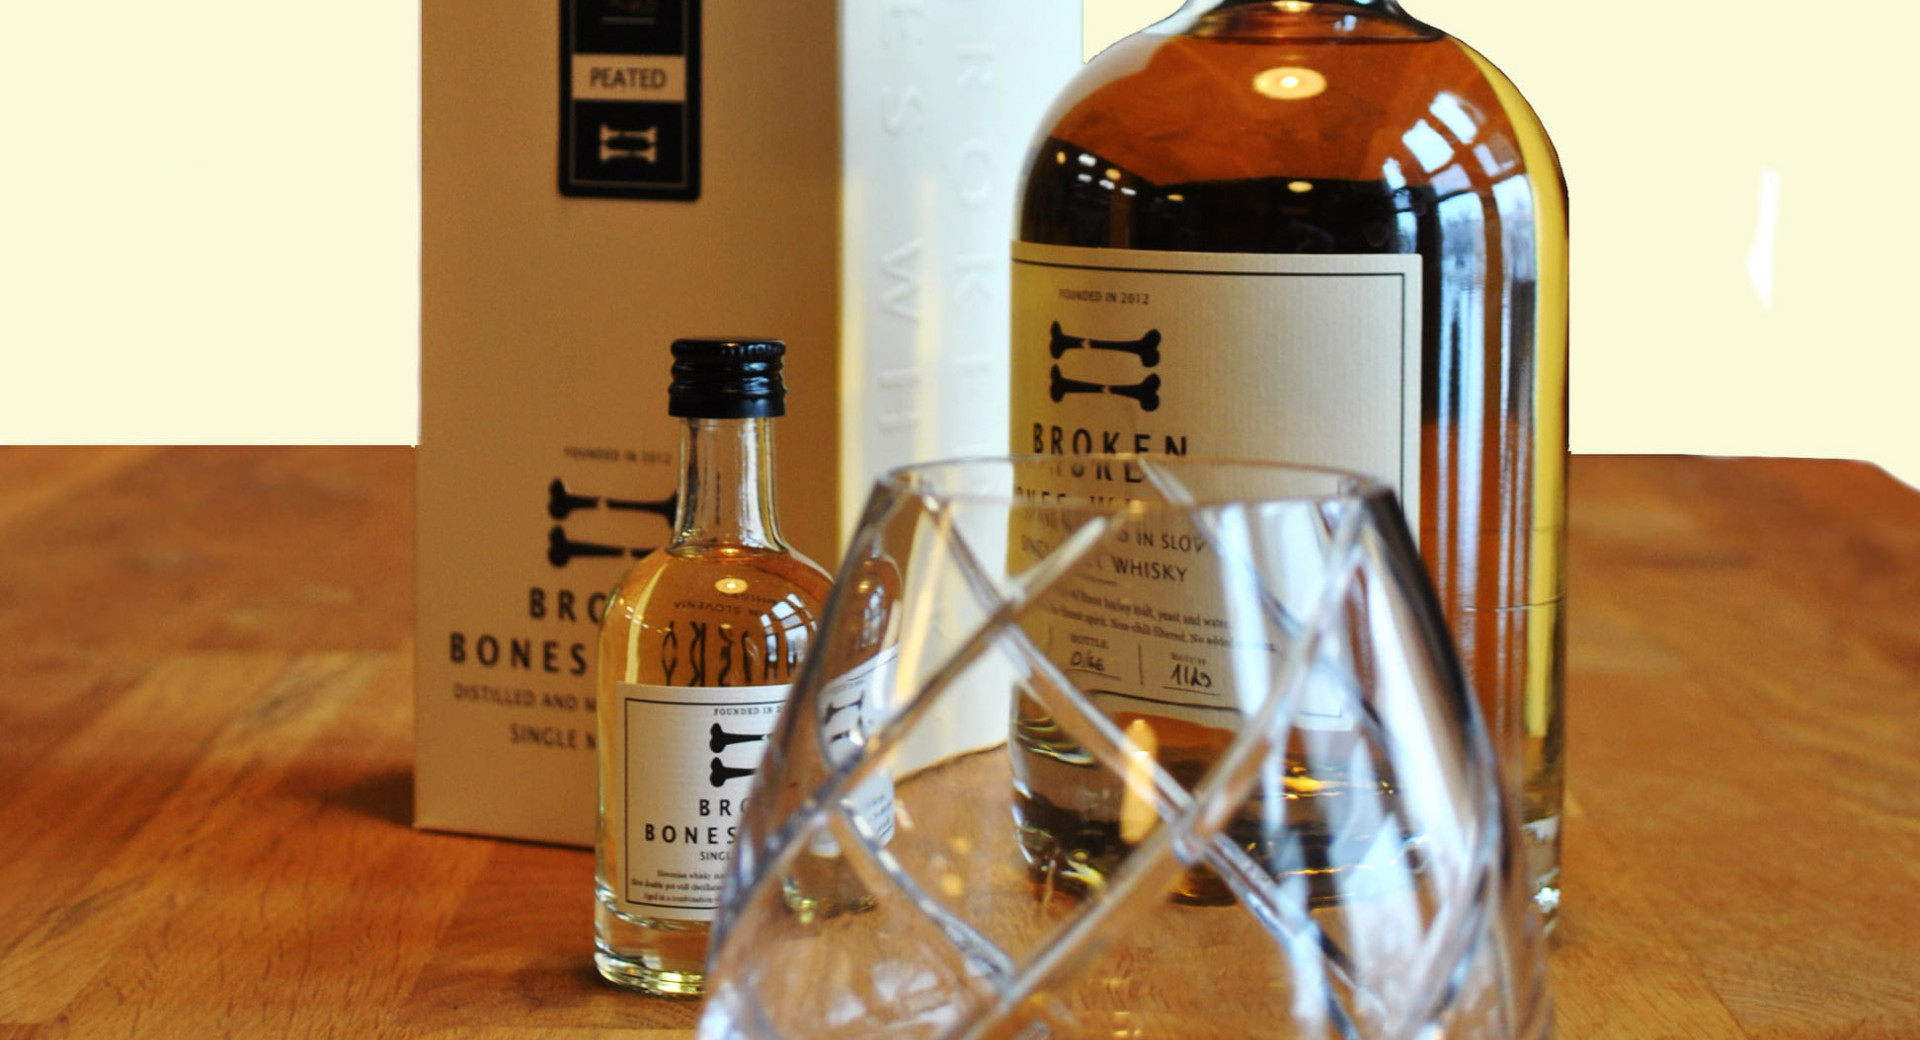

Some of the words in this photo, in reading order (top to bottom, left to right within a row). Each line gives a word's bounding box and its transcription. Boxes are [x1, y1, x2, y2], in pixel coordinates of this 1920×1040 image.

[588, 66, 668, 91] PEATED
[1058, 288, 1103, 303] FOUNDED
[1106, 291, 1117, 303] IN
[1121, 292, 1150, 305] 2012
[1032, 422, 1188, 457] BROKEN
[623, 449, 637, 463] IN
[1137, 530, 1155, 548] IN
[1111, 556, 1188, 582] WHISKY
[1157, 609, 1180, 626] yeast
[1182, 610, 1201, 627] and
[1189, 632, 1203, 646] No
[449, 631, 588, 677] BONES
[452, 682, 536, 708] DISTILLED
[540, 688, 577, 711] AND
[713, 706, 760, 717] FOUNDED
[762, 706, 773, 715] IN
[509, 722, 584, 749] SINGLE
[644, 823, 737, 845] BONES
